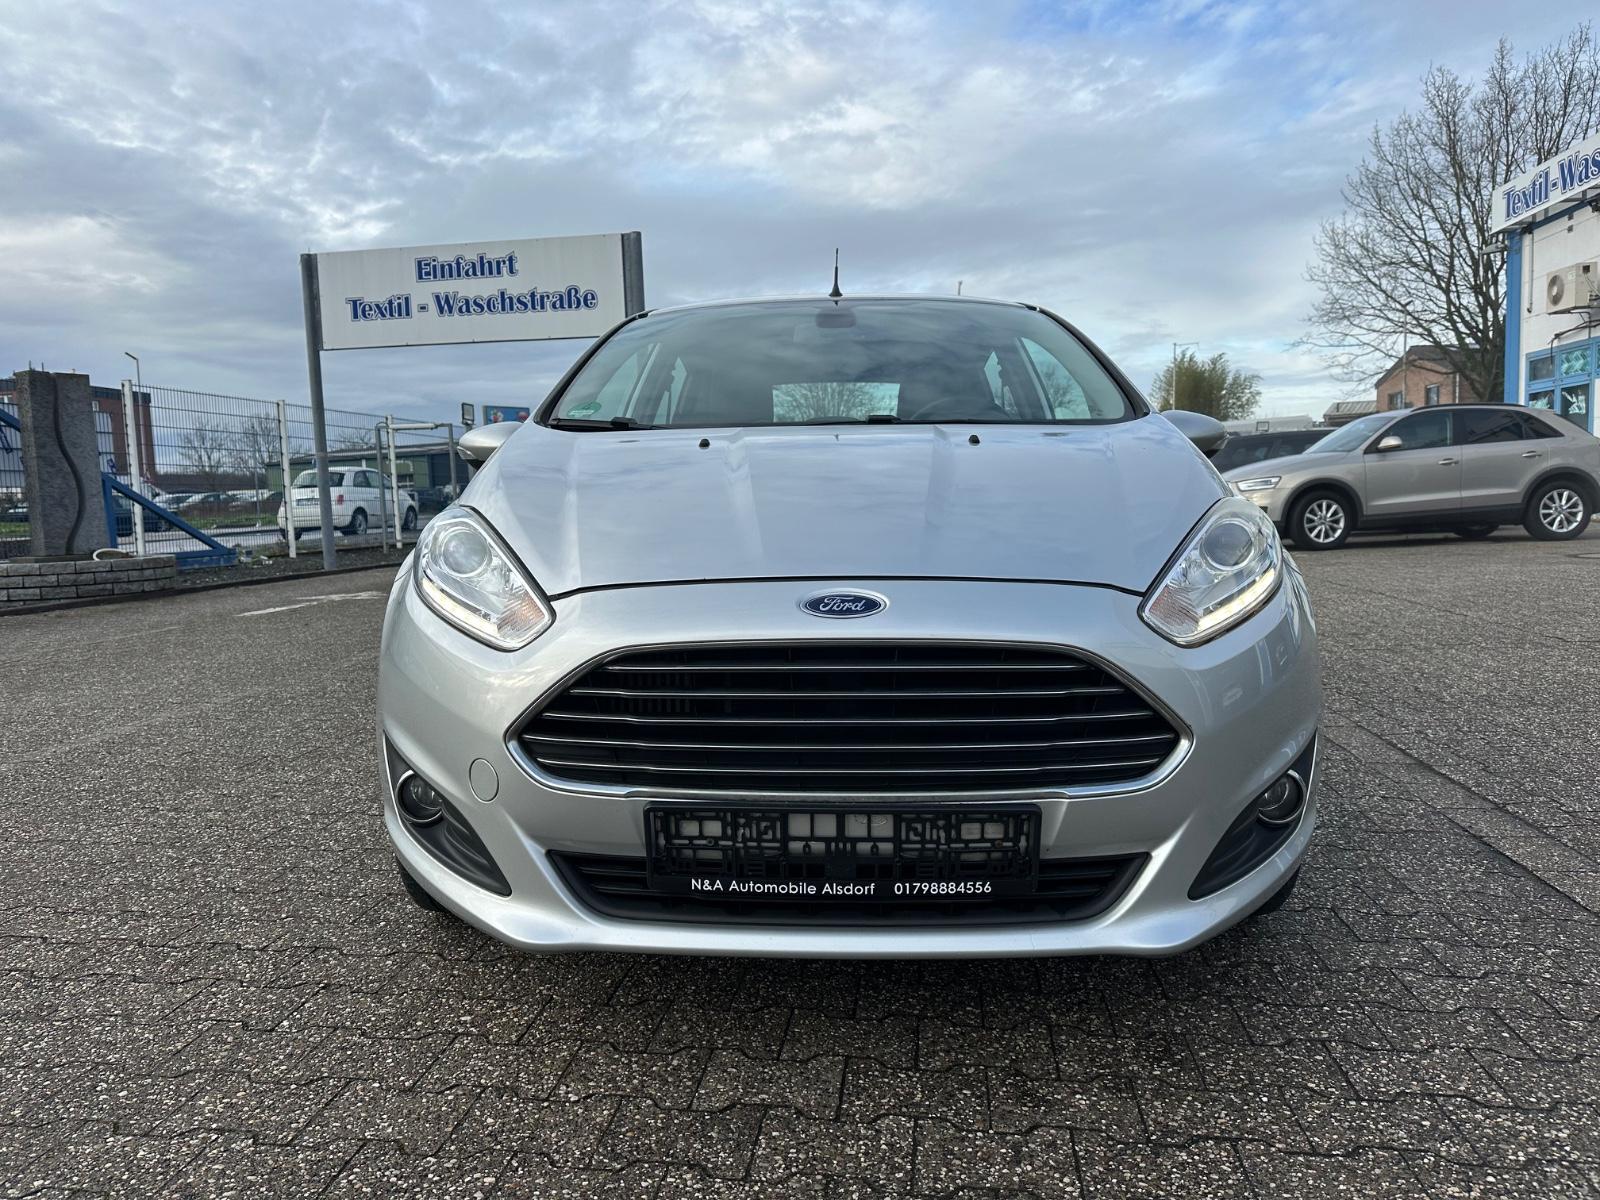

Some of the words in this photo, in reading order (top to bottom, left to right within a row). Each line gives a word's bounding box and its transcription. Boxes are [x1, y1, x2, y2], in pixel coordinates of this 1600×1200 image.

[415, 251, 518, 282] Einfahrt
[345, 294, 412, 321] Textil
[432, 285, 597, 317] Waschstraße
[819, 596, 865, 611] Ford
[691, 878, 723, 891] N&A
[729, 880, 817, 895] Automobile
[822, 882, 875, 895] Alsdorf
[894, 881, 992, 895] 01798884556
